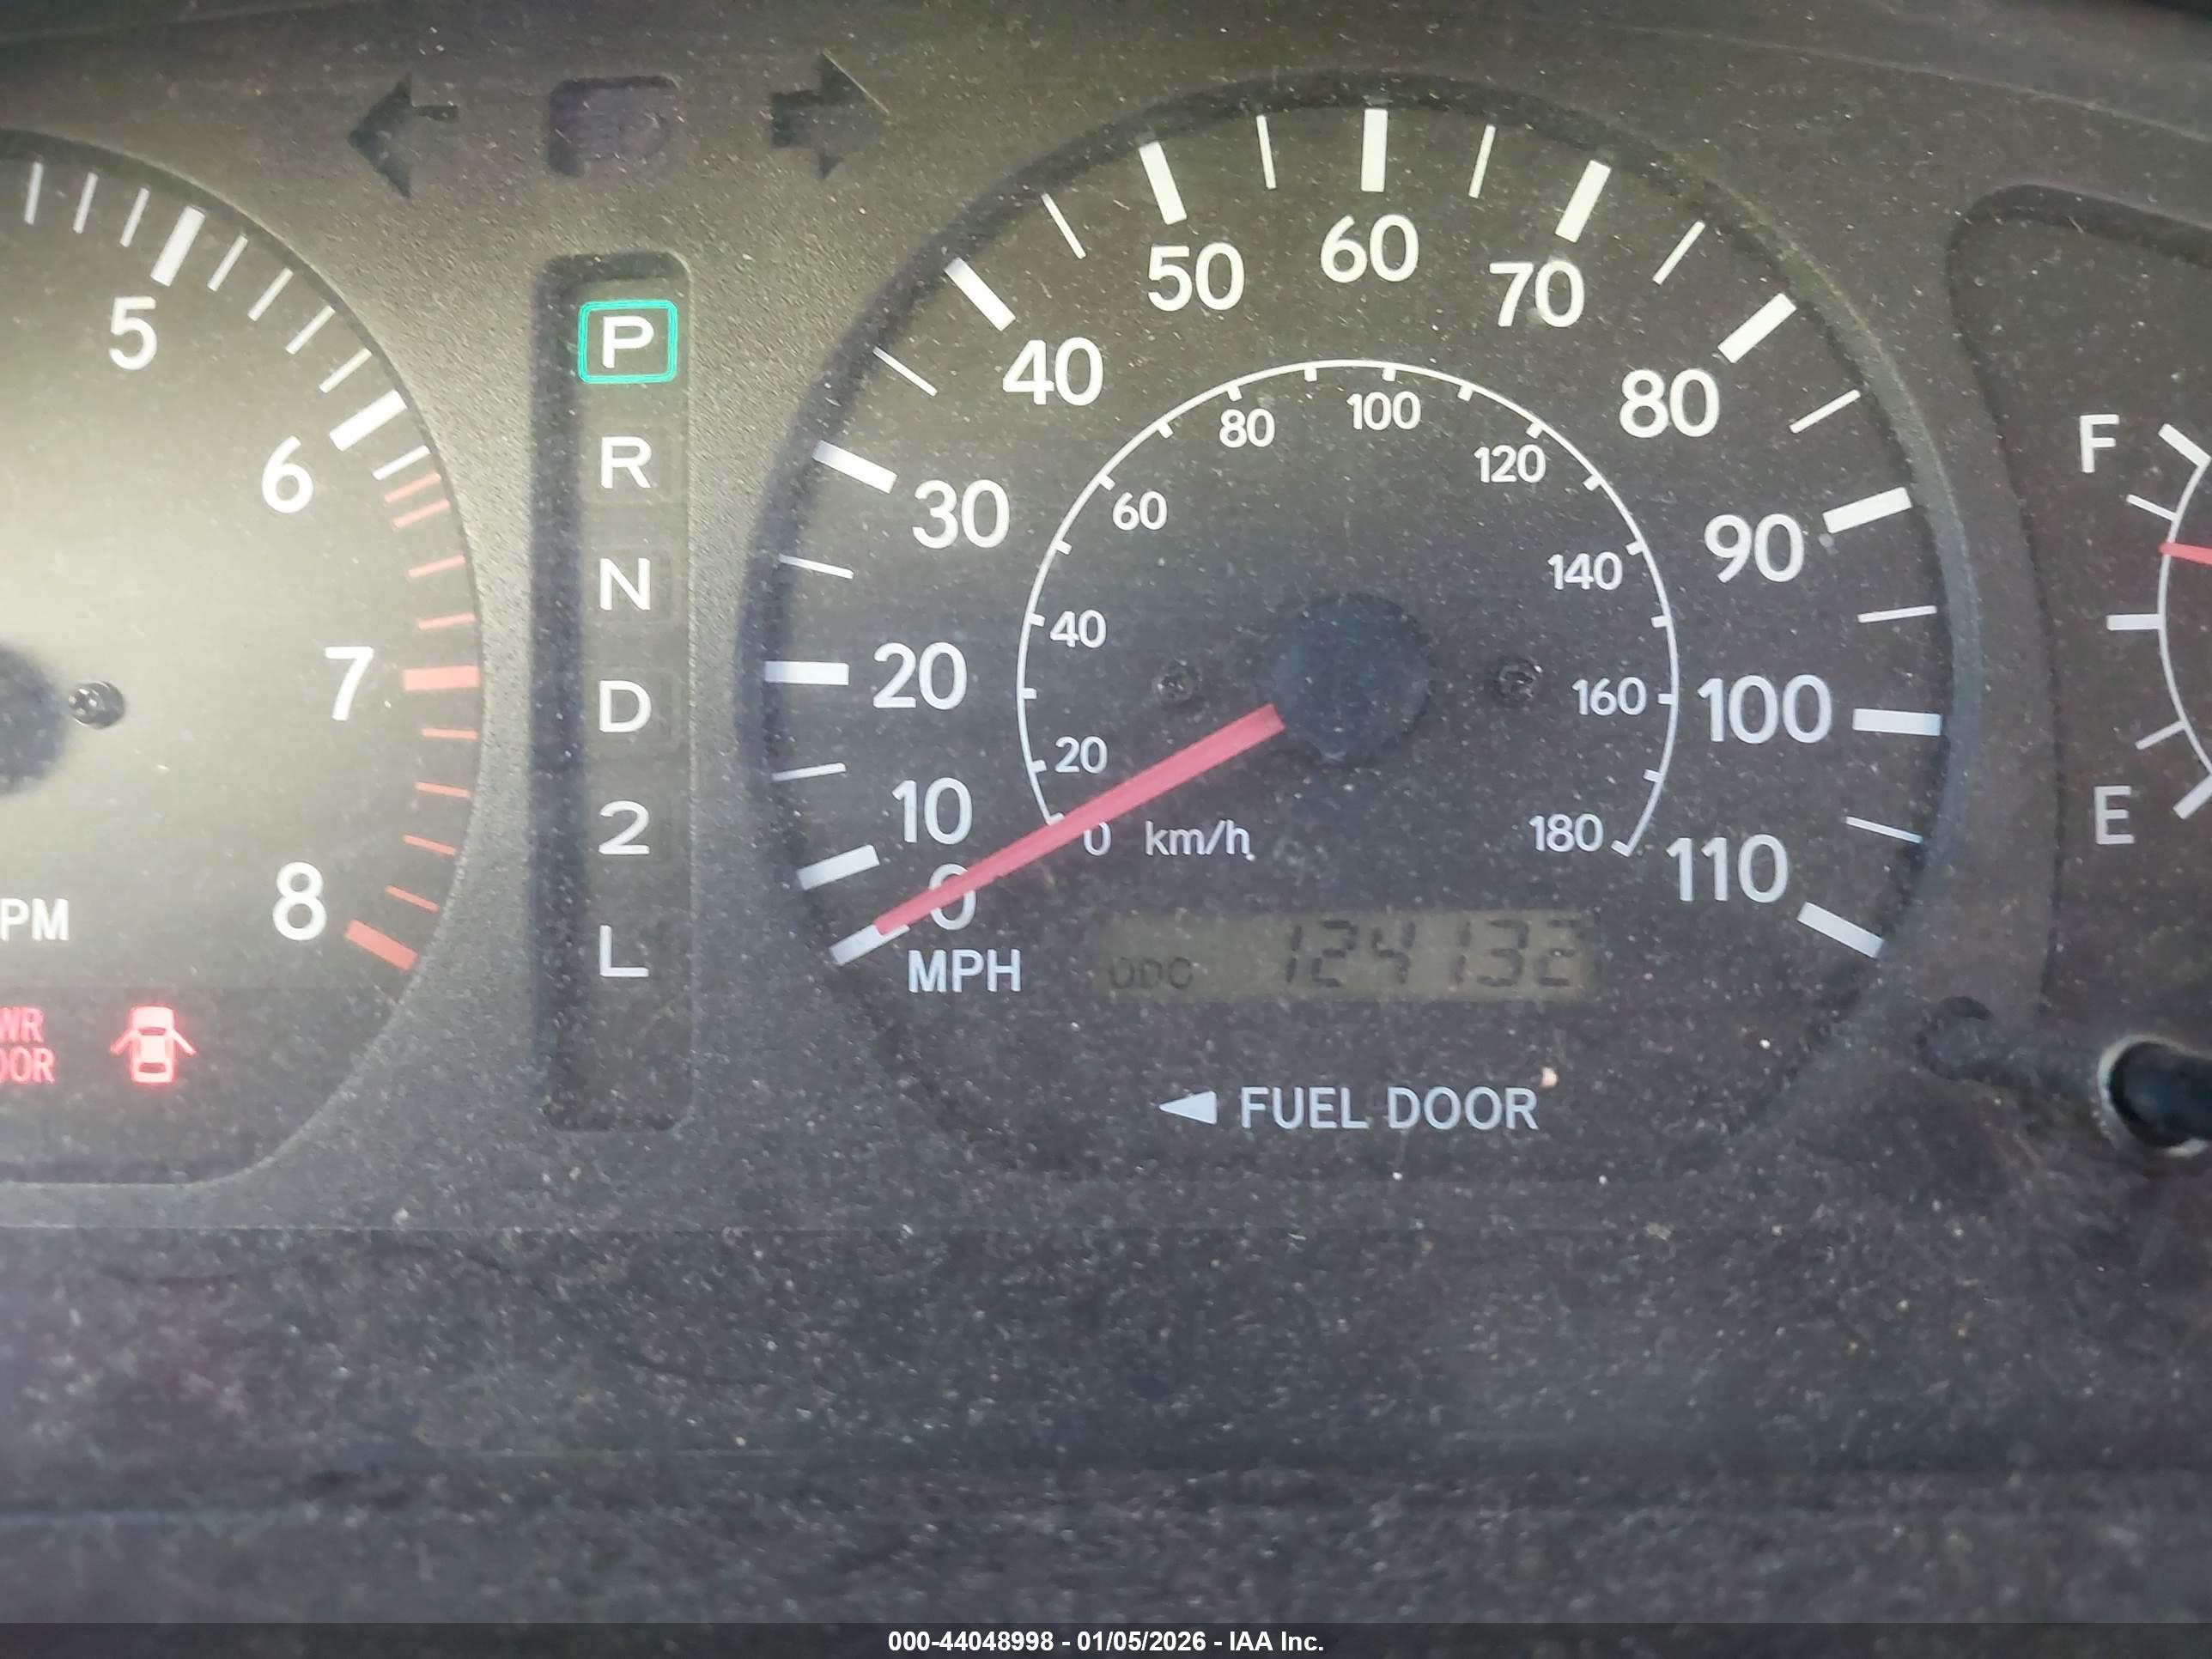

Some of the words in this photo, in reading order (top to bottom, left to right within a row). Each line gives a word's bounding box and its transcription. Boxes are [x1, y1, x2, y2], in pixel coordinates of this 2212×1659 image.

[1149, 243, 1244, 311] 50
[1321, 215, 1419, 283] 60
[1490, 259, 1584, 327] 70
[110, 297, 156, 370] 5
[601, 316, 654, 368] P
[1003, 337, 1103, 405] 40
[1220, 409, 1274, 447] 80
[1347, 392, 1420, 430] 100
[1620, 369, 1719, 438] 80
[601, 437, 651, 489] R
[1474, 445, 1546, 483] 120
[2080, 415, 2119, 472] F
[262, 436, 313, 513] 6
[913, 480, 1009, 548] 30
[1113, 491, 1167, 530] 60
[1548, 552, 1622, 590] 140
[1705, 514, 1804, 582] 90
[600, 558, 650, 610] N
[1050, 611, 1106, 647] 40
[325, 647, 374, 720] 7
[873, 642, 966, 709] 20
[1572, 678, 1646, 715] 160
[600, 681, 651, 732] D
[1698, 675, 1832, 743] 100
[1055, 737, 1107, 773] 20
[599, 801, 649, 854] 2
[892, 778, 972, 844] 10
[1146, 819, 1250, 855] km/h
[1529, 814, 1603, 852] 180
[2095, 786, 2134, 844] E
[929, 864, 976, 930] 0
[1667, 835, 1788, 902] 110
[273, 862, 325, 940] 8
[600, 926, 648, 976] L
[909, 950, 1020, 993] MPH
[1286, 919, 1589, 988] 124132
[1241, 1087, 1369, 1128] FUEL
[1388, 1087, 1538, 1129] DOOR
